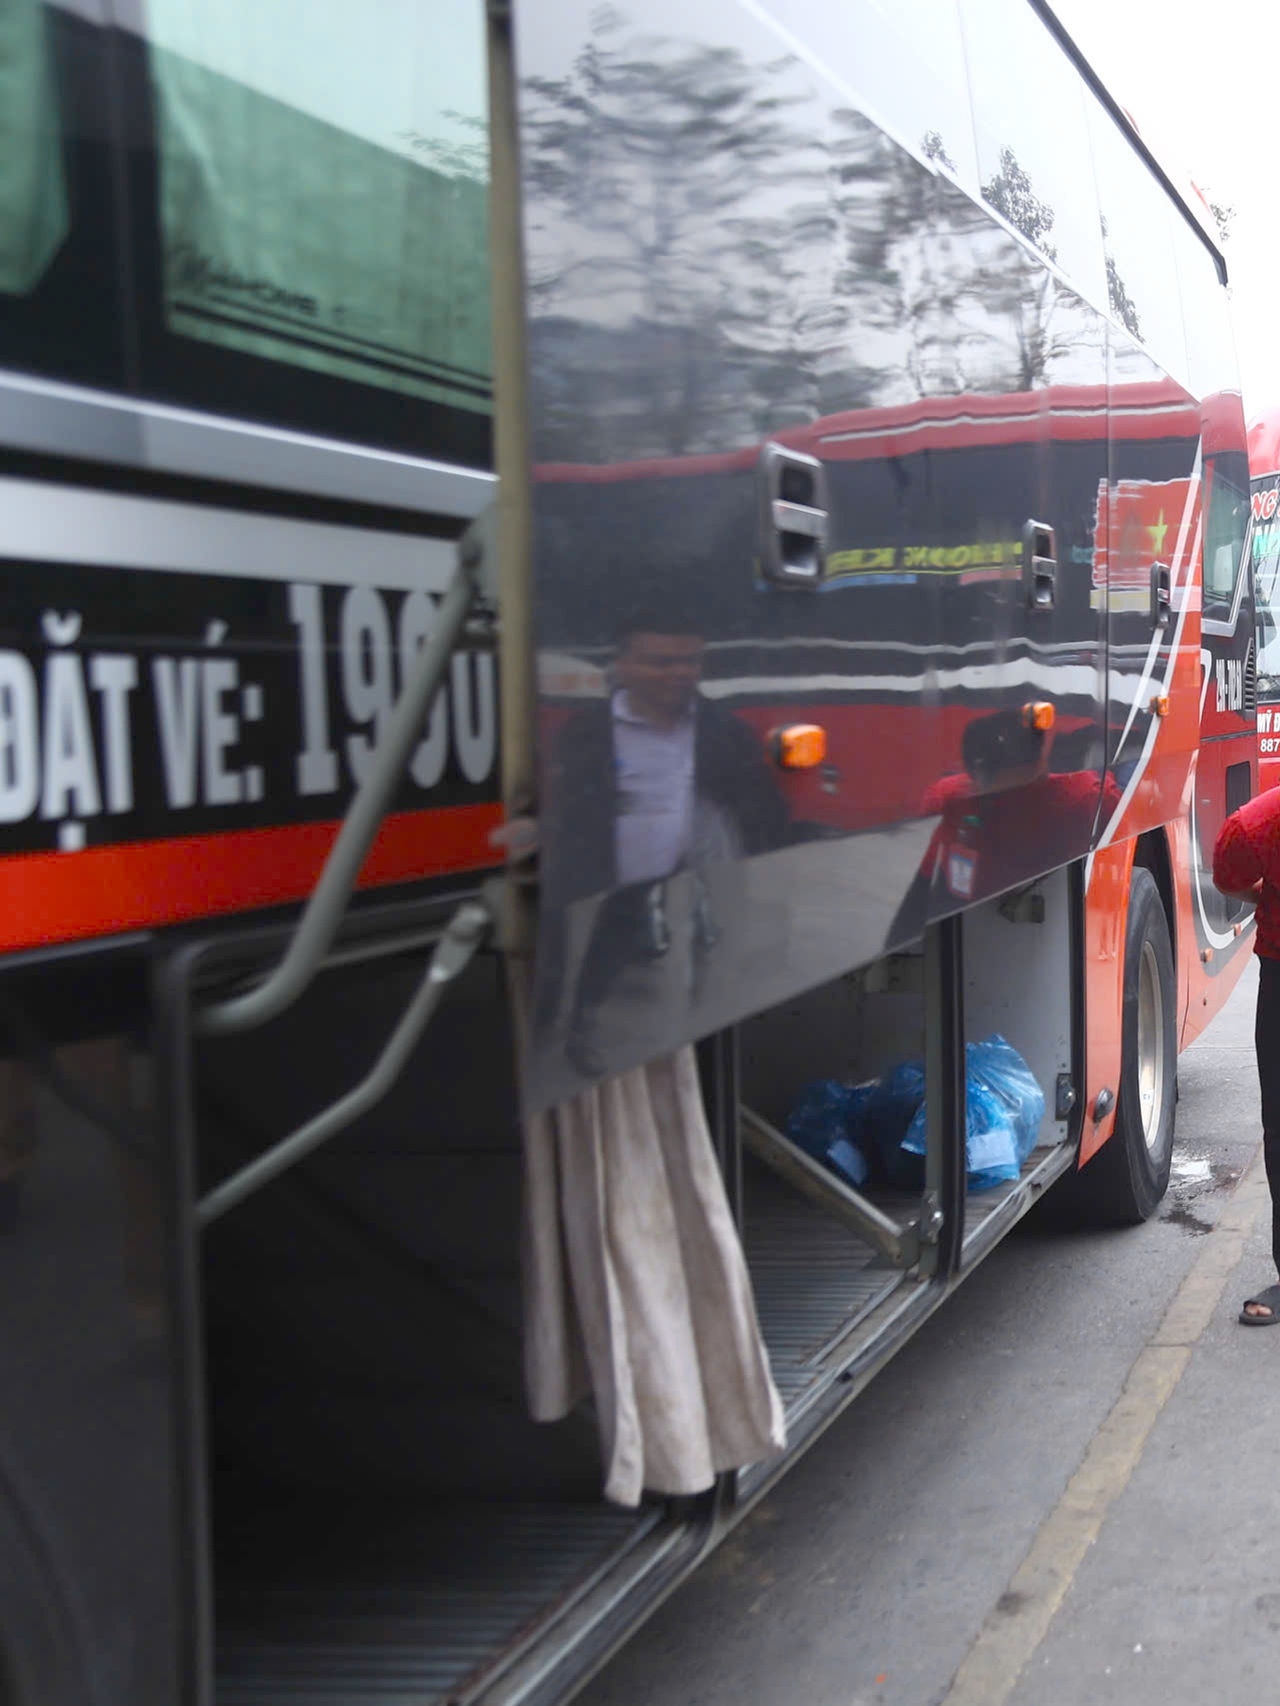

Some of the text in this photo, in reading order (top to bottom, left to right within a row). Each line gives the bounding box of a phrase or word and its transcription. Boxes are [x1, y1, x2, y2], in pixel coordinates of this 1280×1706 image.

[1250, 490, 1278, 520] NG
[0, 608, 139, 852] ĐẶT
[152, 619, 264, 809] VÉ:
[1260, 738, 1280, 752] 887
